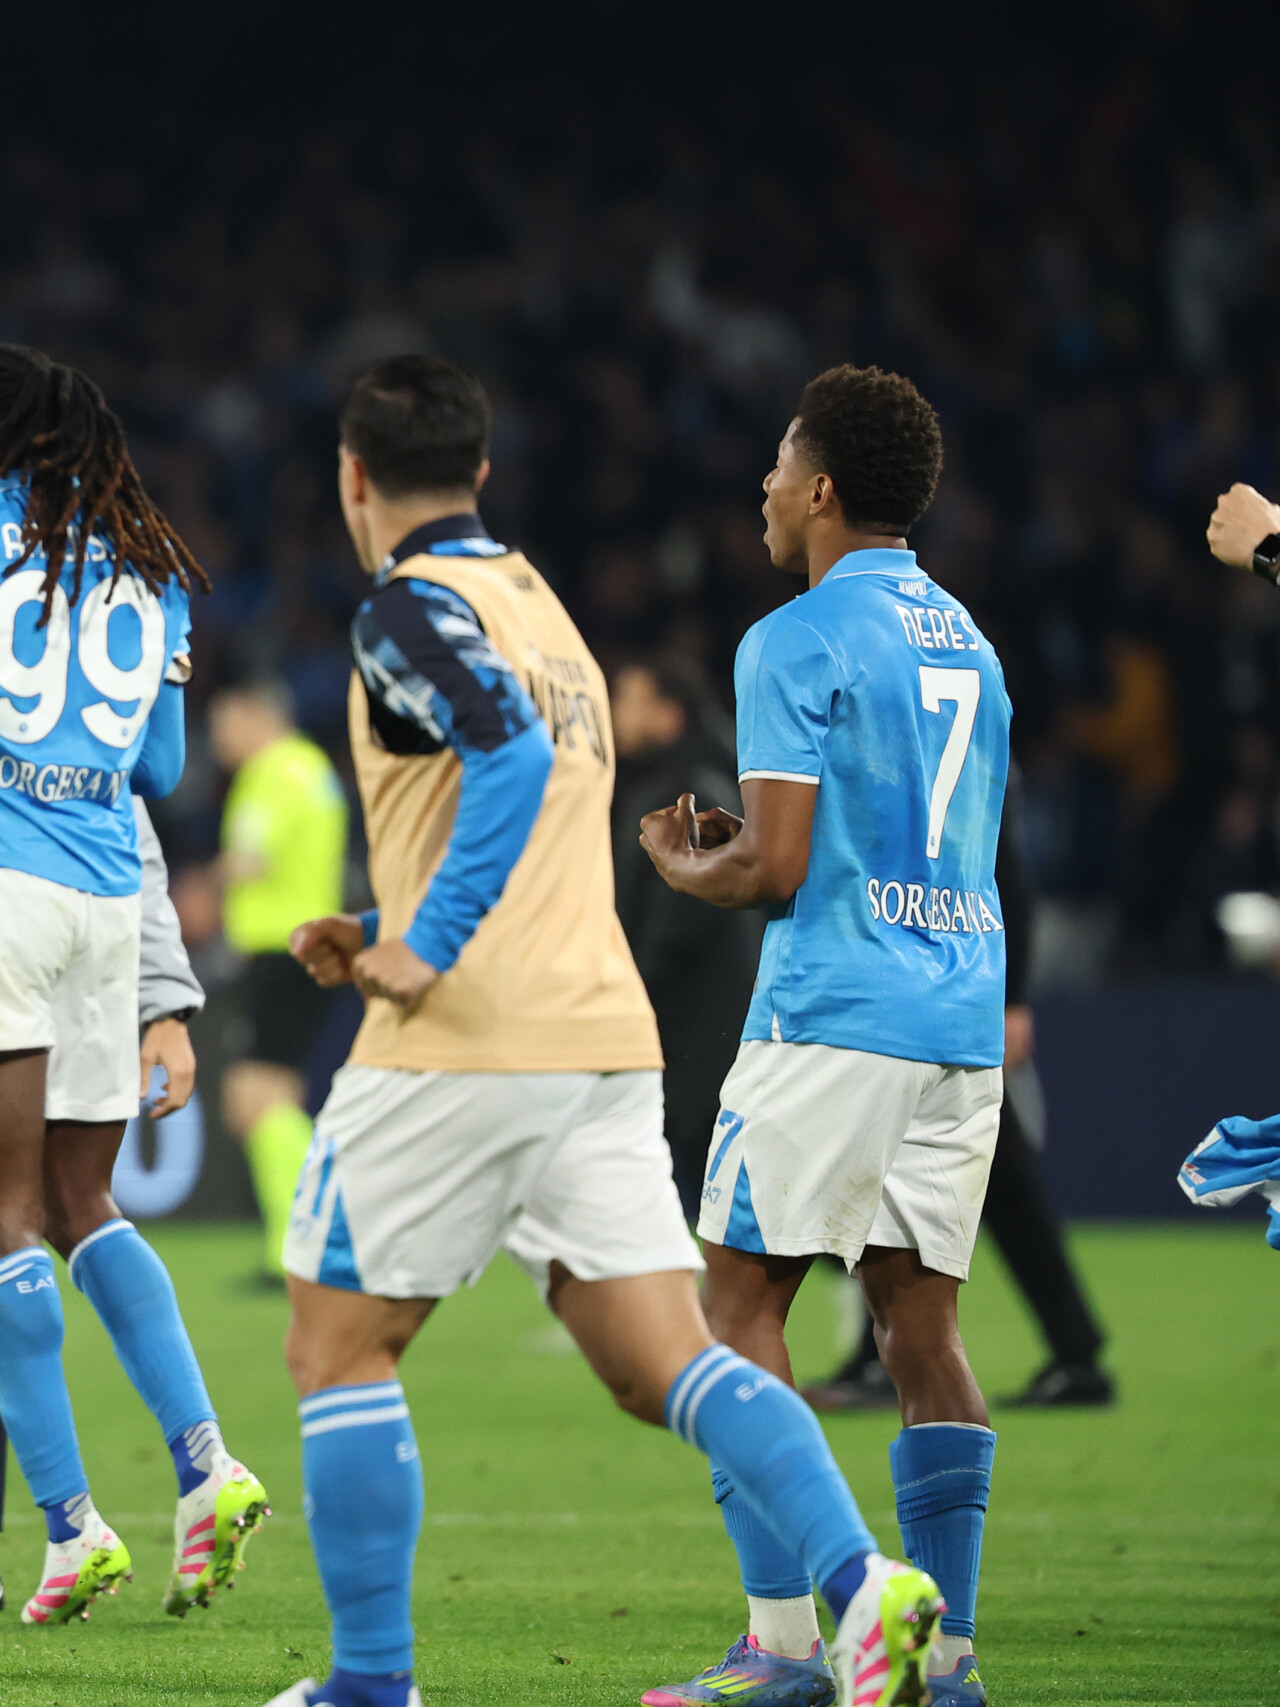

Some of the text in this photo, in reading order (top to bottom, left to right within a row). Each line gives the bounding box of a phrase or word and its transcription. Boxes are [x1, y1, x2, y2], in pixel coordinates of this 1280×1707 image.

[894, 604, 980, 651] NERES
[918, 665, 980, 859] 7
[867, 877, 1004, 933] SORGESANA
[708, 1109, 745, 1182] 7
[701, 1181, 722, 1205] EA7
